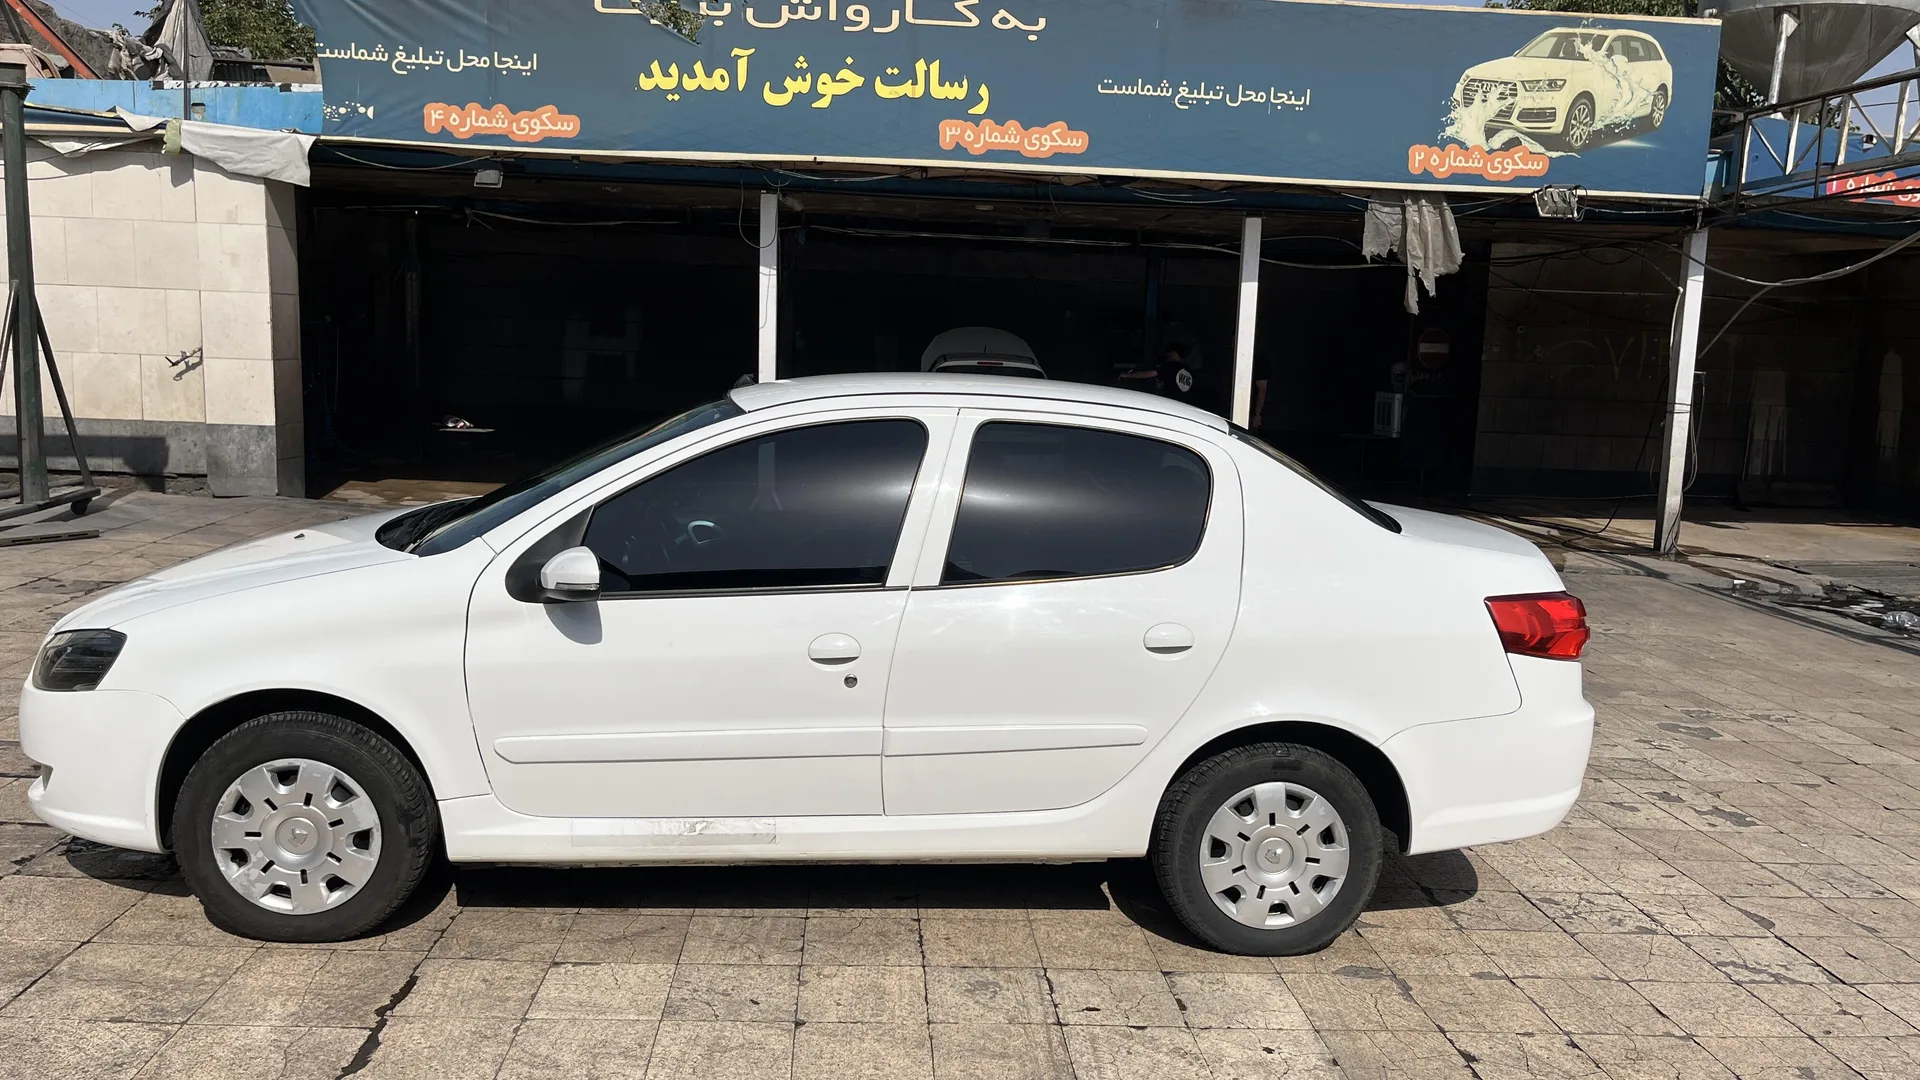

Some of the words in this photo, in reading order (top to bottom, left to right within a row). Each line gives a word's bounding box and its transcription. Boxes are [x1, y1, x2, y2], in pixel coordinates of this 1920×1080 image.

[314, 42, 389, 62] شماست
[391, 44, 445, 75] تبلیغ
[446, 48, 491, 73] محل
[493, 51, 538, 76] اینجا
[637, 47, 756, 102] آمدید
[762, 54, 866, 109] خوش
[874, 57, 990, 115] رسالت
[1097, 78, 1173, 97] شماست
[1174, 80, 1225, 110] تبلیغ
[1226, 83, 1267, 108] محل
[1269, 86, 1312, 111] اینجا
[430, 108, 445, 127] ۴
[448, 108, 509, 132] شماره
[512, 111, 574, 136] سکوی
[945, 125, 961, 144] ۳
[964, 126, 1020, 148] شماره
[1023, 127, 1083, 152] سکوی
[1414, 151, 1425, 168] ۲
[1429, 150, 1484, 172] شماره
[1487, 151, 1543, 175] سکوی
